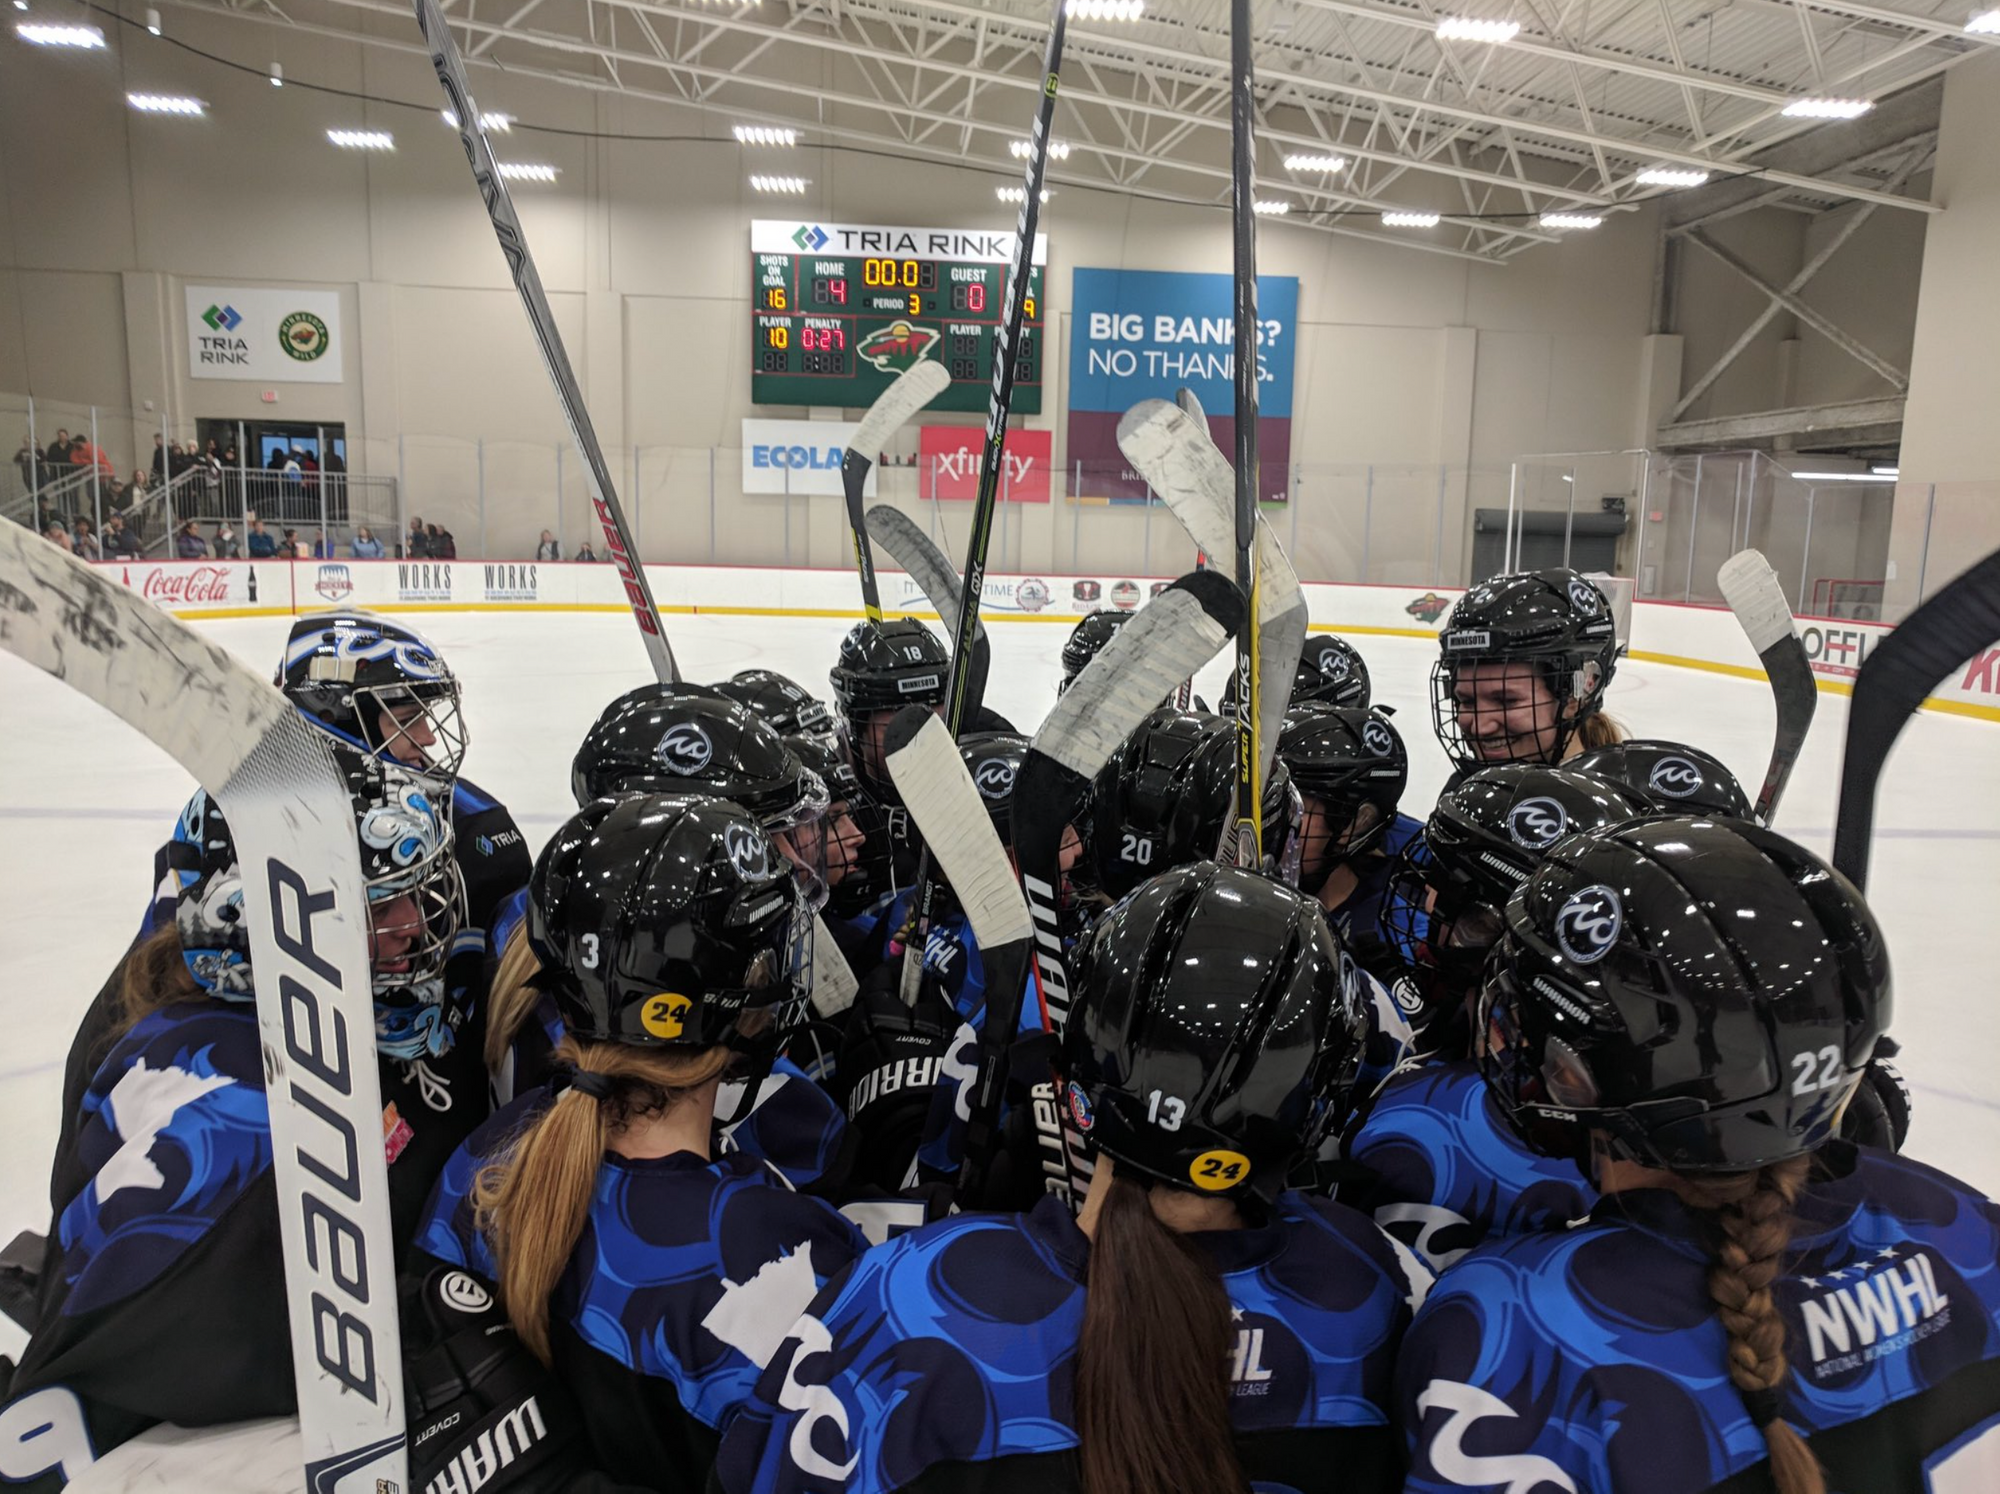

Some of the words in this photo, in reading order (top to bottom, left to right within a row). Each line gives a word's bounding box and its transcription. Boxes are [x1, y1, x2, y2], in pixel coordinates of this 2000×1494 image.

[837, 230, 918, 253] TRIA
[928, 235, 1008, 257] RINK
[760, 255, 789, 267] SHOTS
[767, 265, 781, 276] ON
[815, 262, 845, 276] HOME
[762, 275, 786, 286] GOAL
[951, 269, 987, 282] GUEST
[768, 289, 786, 309] 16
[828, 278, 847, 304] 4
[967, 284, 986, 312] 0
[873, 298, 904, 310] PERIOD
[908, 293, 920, 315] 3
[759, 316, 791, 328] PLAYER
[804, 318, 842, 330] PENALTY
[950, 324, 982, 336] PLAYER
[1090, 312, 1144, 342] BIG
[198, 336, 248, 351] TRIA
[769, 328, 787, 349] 10
[200, 351, 249, 365] RINK
[1089, 348, 1137, 377] NO
[752, 445, 843, 469] ECOLA
[398, 564, 451, 590] WORKS
[484, 564, 537, 590] WORKS
[983, 584, 1013, 597] TIME
[963, 602, 977, 653] ALPHA
[1450, 635, 1486, 647] MINNESOTA
[903, 646, 922, 660] 18
[902, 678, 936, 690] MINNESOTA
[491, 829, 521, 848] TRIA
[1121, 834, 1151, 866] 20
[1480, 851, 1529, 884] WARRIO
[922, 880, 933, 915] BRANDT
[749, 895, 785, 923] WARRIOR
[581, 932, 600, 969] 3
[1533, 977, 1591, 1025] WARRIOR
[651, 1002, 686, 1023] 24
[896, 1035, 931, 1046] COVERT
[1791, 1044, 1841, 1098] 22
[1148, 1089, 1186, 1132] 13
[1538, 1109, 1578, 1122] CCM
[1199, 1158, 1242, 1179] 24
[1800, 1253, 1950, 1362] NWHL
[1236, 1383, 1271, 1396] LEAGUE
[415, 1412, 460, 1447] COVERT
